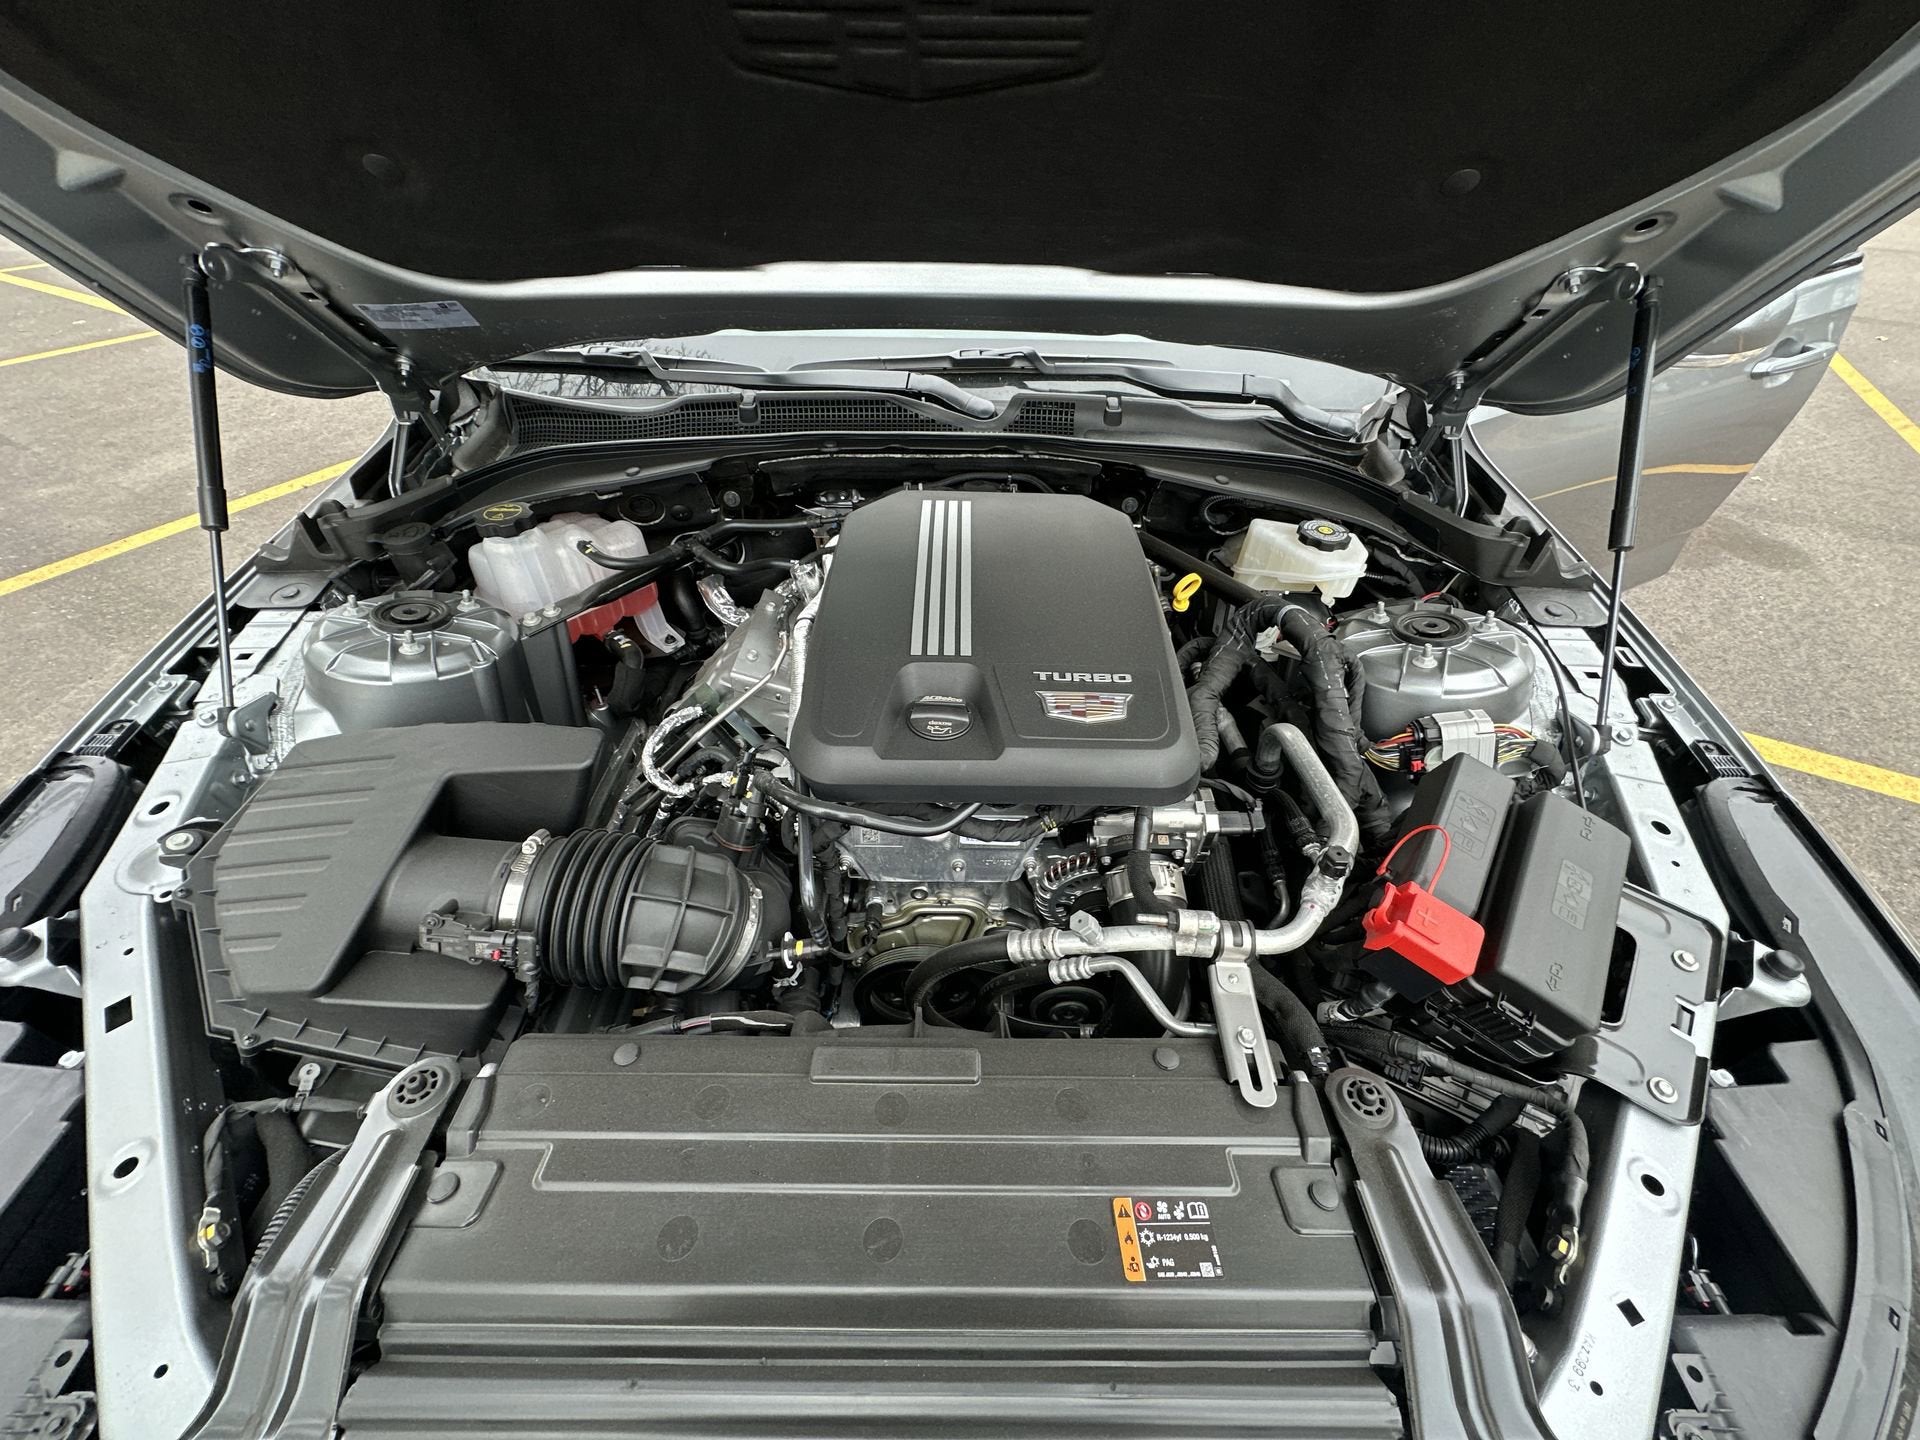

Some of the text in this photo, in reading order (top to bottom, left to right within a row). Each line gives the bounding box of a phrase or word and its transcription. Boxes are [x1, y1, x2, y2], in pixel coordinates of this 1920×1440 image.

[1032, 671, 1133, 683] TURBO
[1183, 1233, 1199, 1241] 0.500
[1199, 1232, 1209, 1242] kg
[1161, 1258, 1175, 1267] PAG
